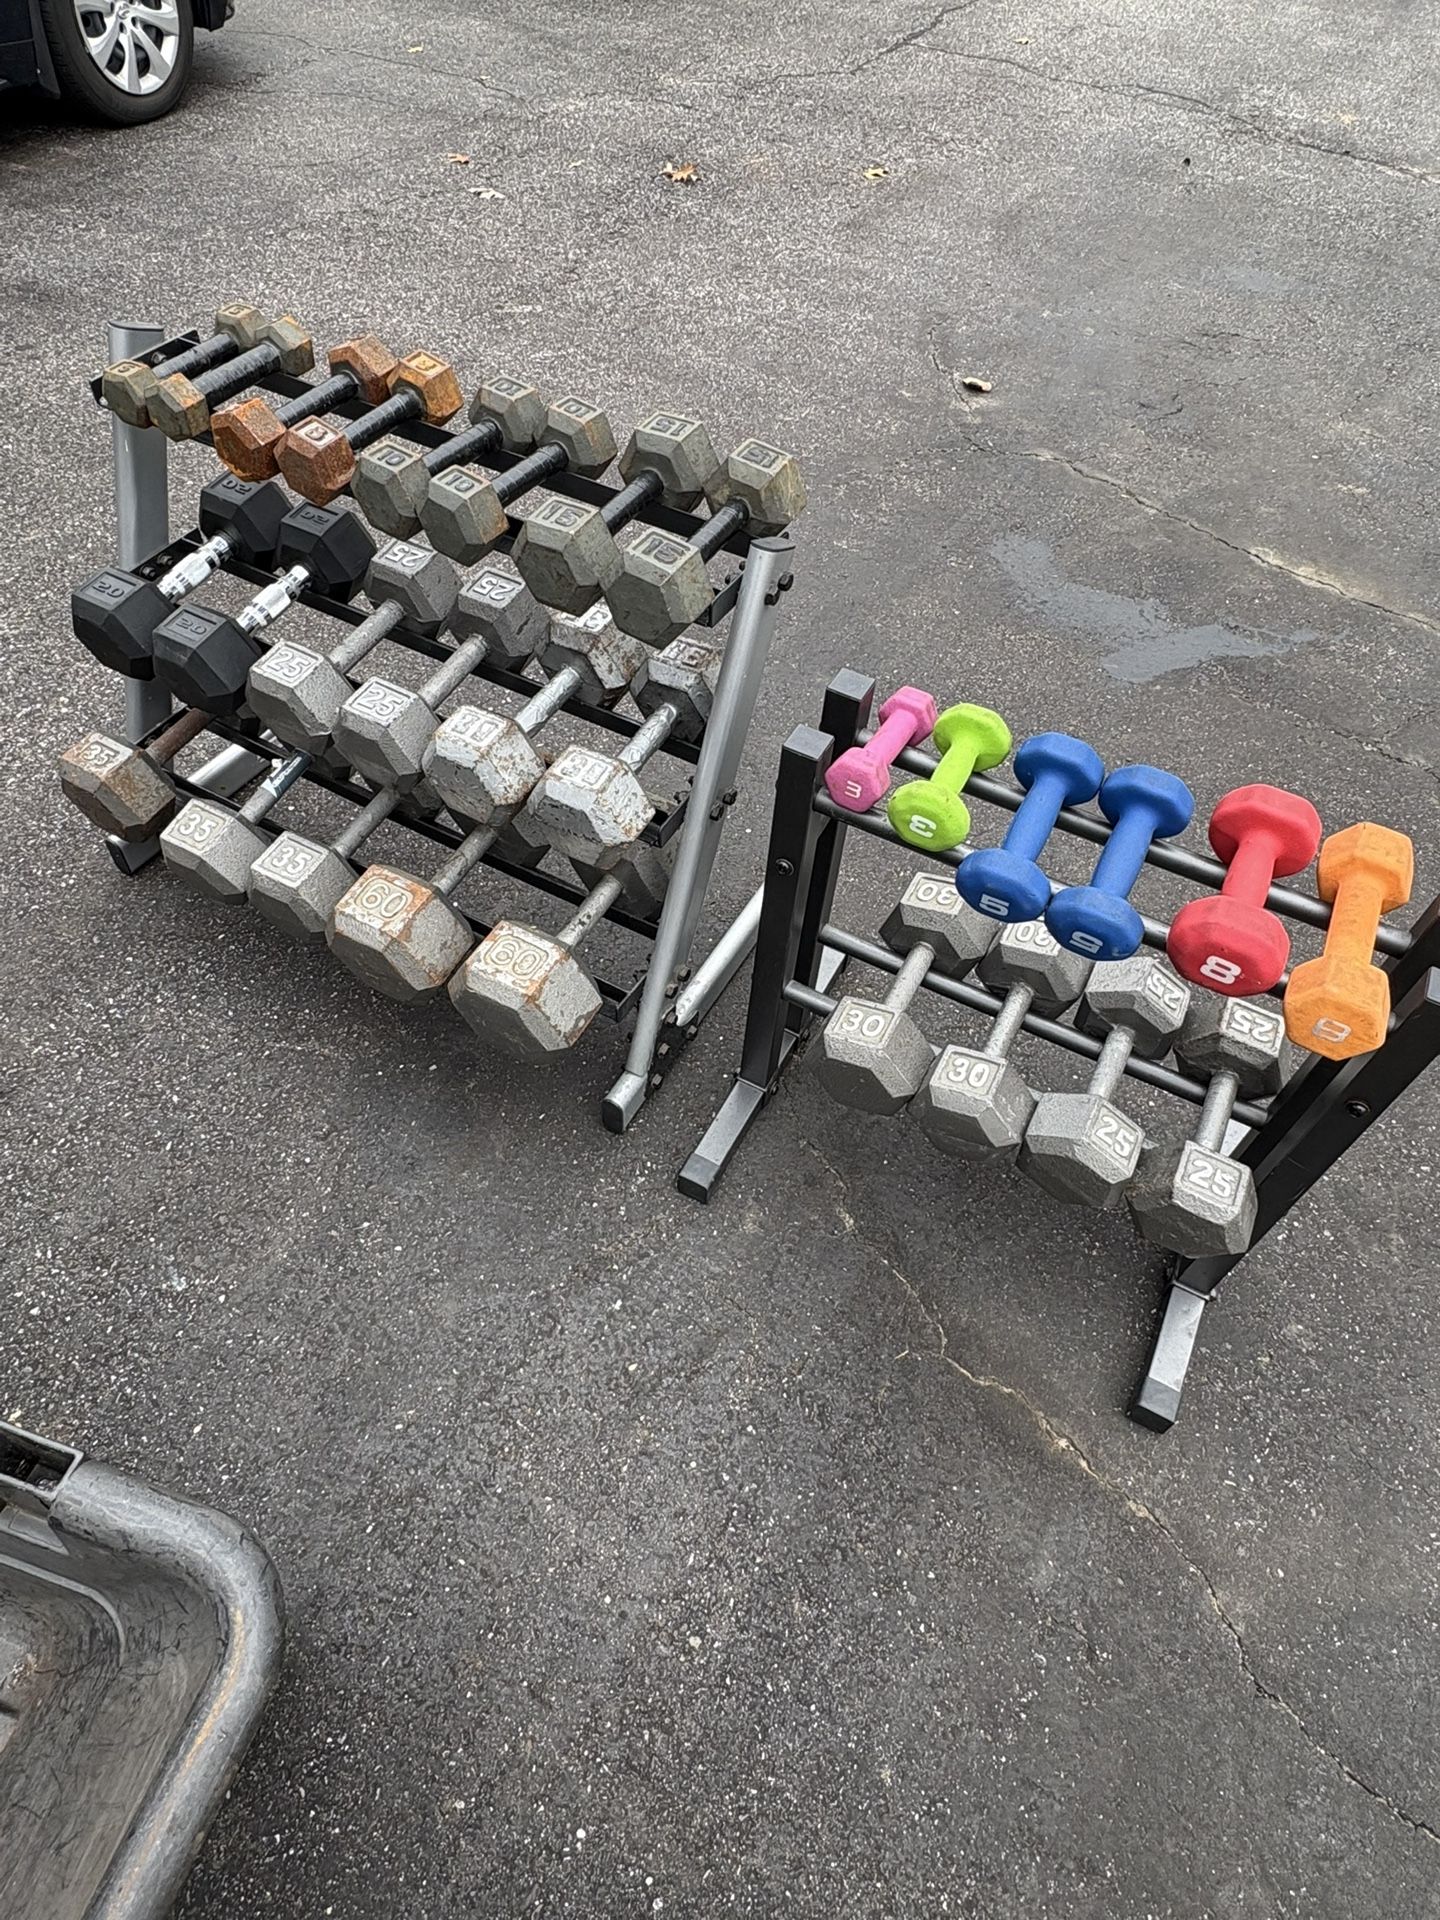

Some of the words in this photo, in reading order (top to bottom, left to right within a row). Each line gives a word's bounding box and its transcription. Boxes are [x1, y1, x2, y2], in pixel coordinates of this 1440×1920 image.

[494, 383, 522, 396] 10
[563, 402, 591, 418] 10
[650, 417, 688, 436] 15
[377, 451, 406, 465] 10
[740, 446, 780, 469] 15
[221, 480, 252, 495] 20
[444, 474, 475, 492] 10
[301, 511, 330, 525] 20
[542, 504, 585, 528] 15
[385, 545, 427, 568] 25
[641, 537, 687, 564] 15
[93, 581, 125, 598] 20
[473, 577, 516, 601] 25
[176, 617, 207, 635] 20
[267, 651, 312, 678] 25
[357, 689, 404, 716] 25
[82, 742, 120, 766] 35
[844, 780, 862, 799] 3
[179, 813, 217, 842] 35
[909, 814, 938, 839] 3
[272, 847, 313, 875] 35
[362, 884, 407, 918] 60
[916, 884, 957, 906] 30
[979, 893, 1010, 917] 5
[1014, 922, 1051, 946] 30
[1069, 931, 1104, 954] 5
[491, 937, 543, 976] 60
[1200, 955, 1242, 985] 8
[1146, 973, 1183, 1009] 25
[841, 1009, 885, 1038] 30
[1231, 1008, 1274, 1042] 25
[948, 1057, 990, 1088] 30
[1095, 1115, 1136, 1157] 25
[1189, 1159, 1236, 1198] 25
